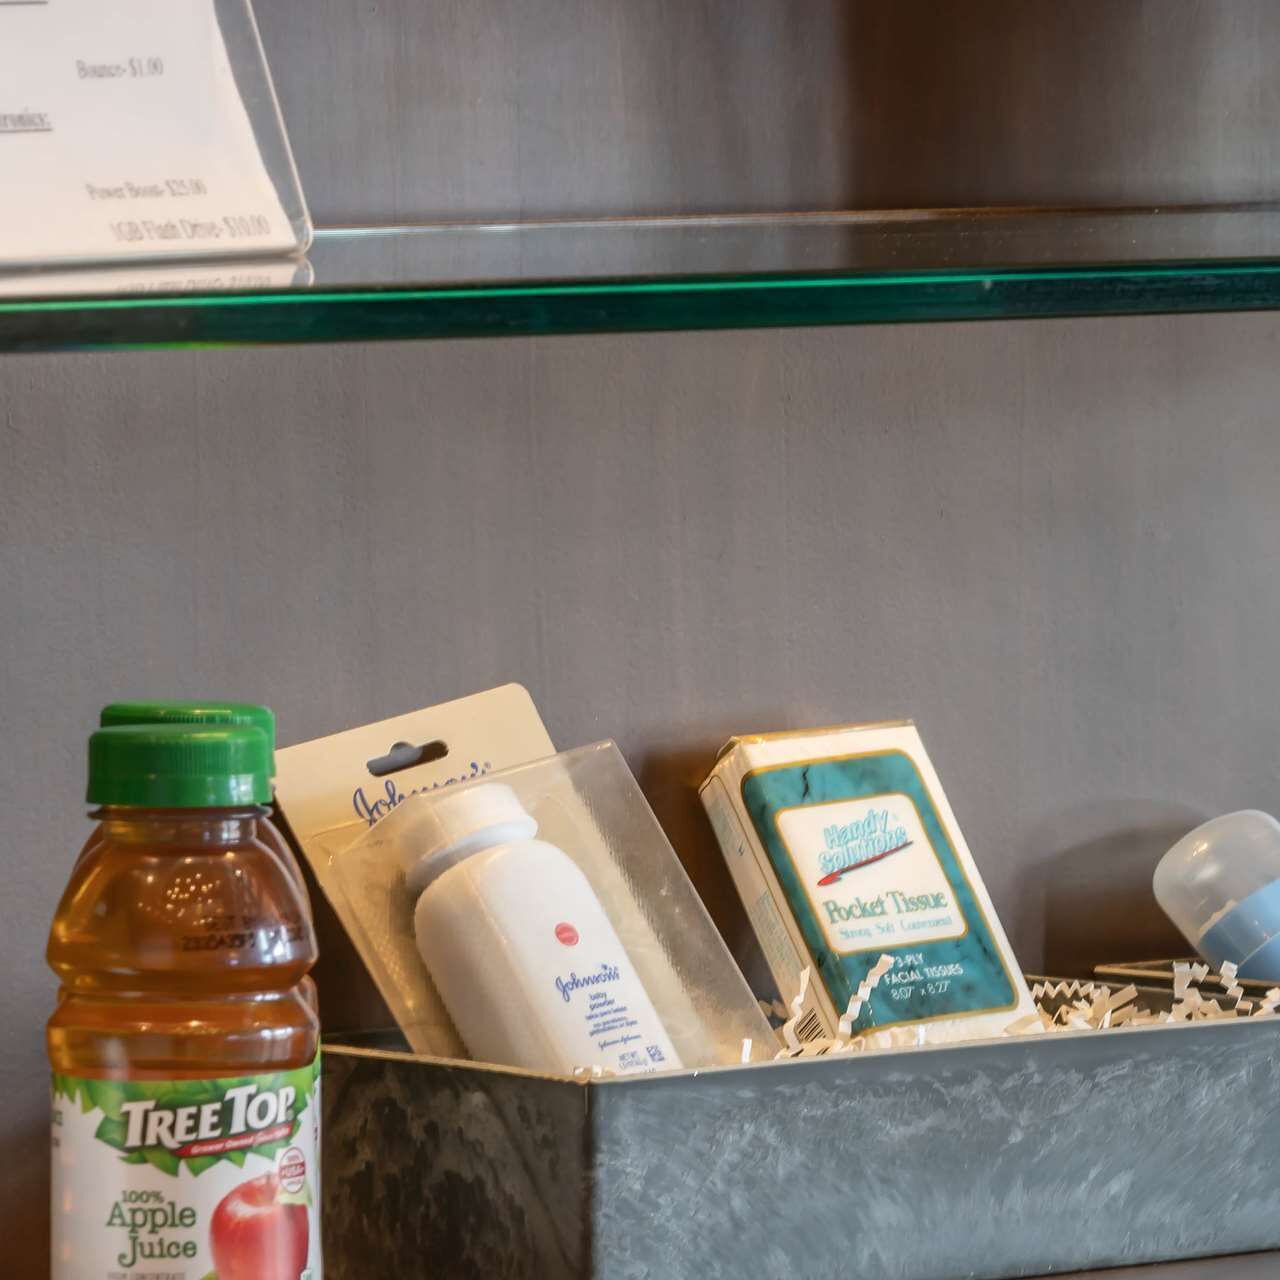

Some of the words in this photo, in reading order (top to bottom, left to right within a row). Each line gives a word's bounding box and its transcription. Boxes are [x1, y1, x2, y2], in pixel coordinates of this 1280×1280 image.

[822, 896, 886, 924] Pocket
[887, 889, 949, 914] Tissue
[120, 1100, 222, 1149] TREE
[224, 1084, 297, 1134] TOP
[122, 1190, 164, 1204] 100%
[106, 1201, 196, 1234] Apple
[118, 1235, 197, 1268] Juice
